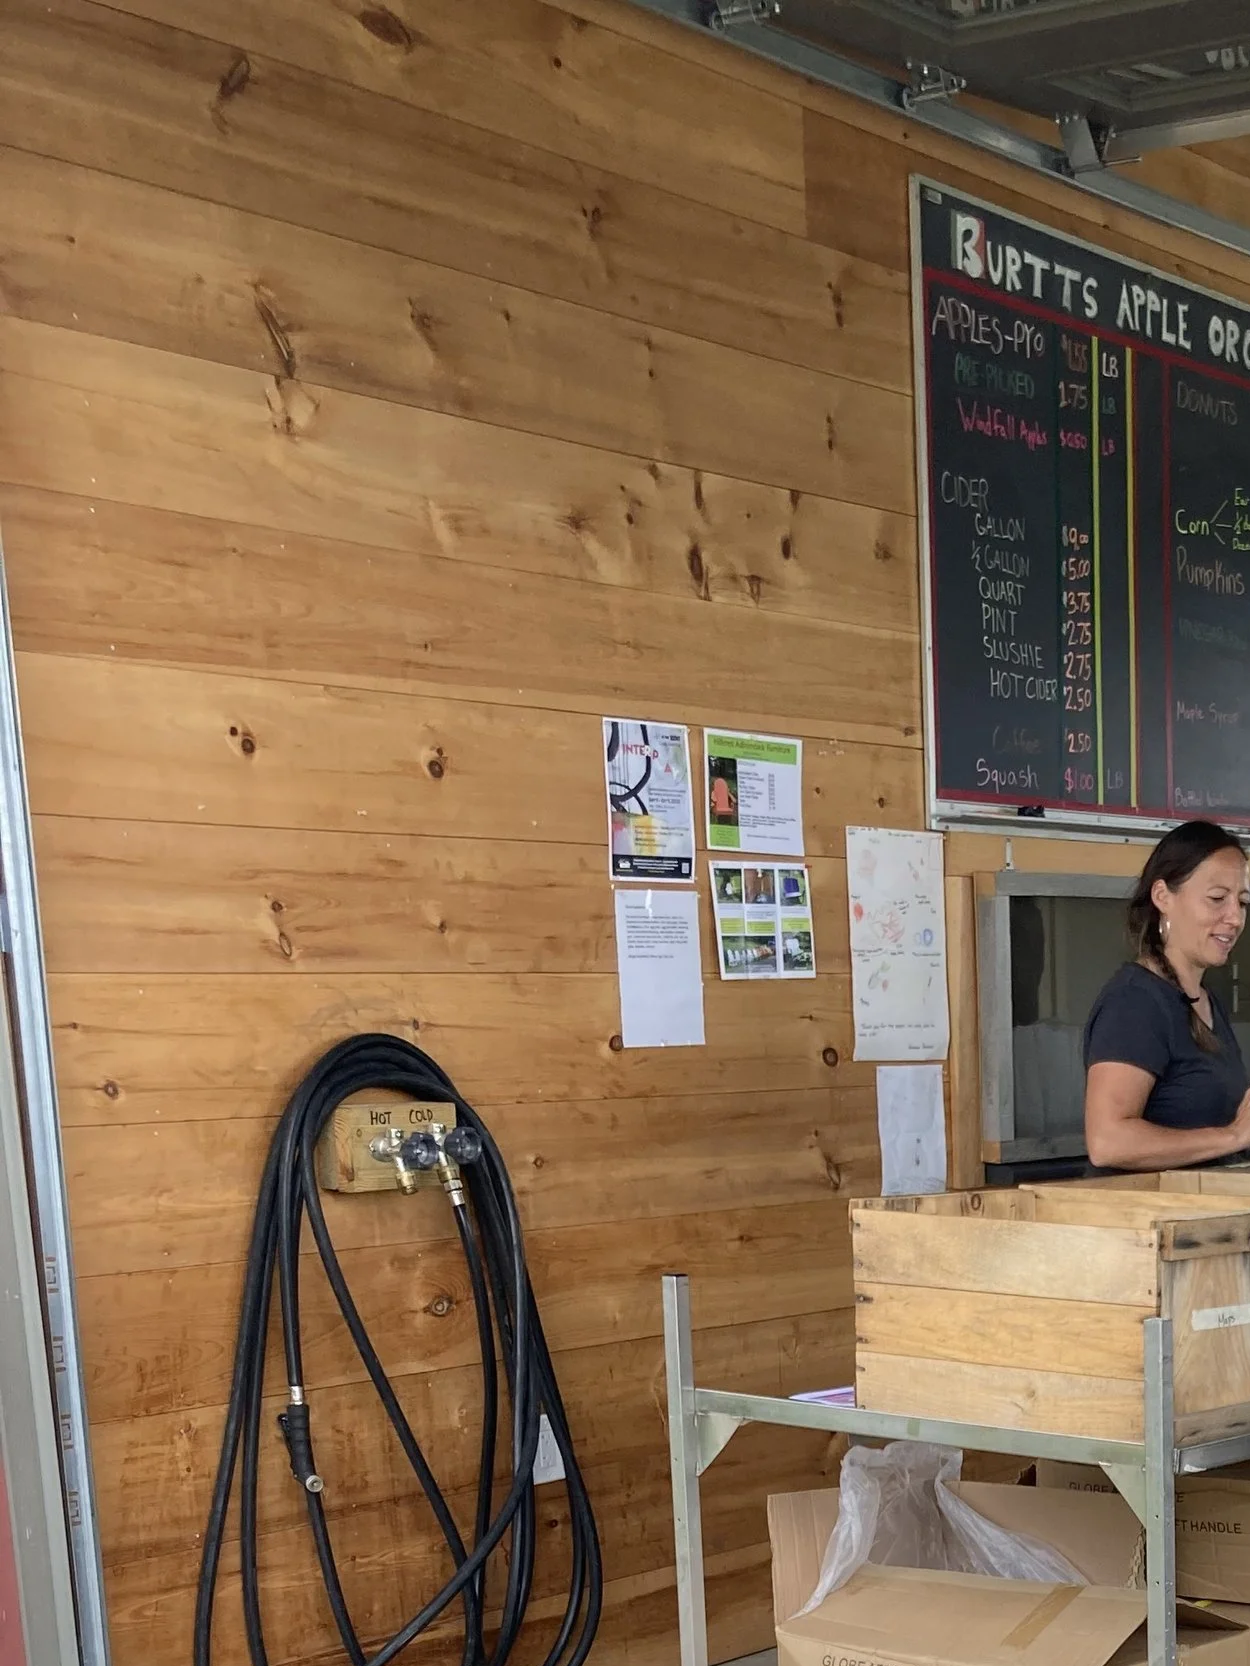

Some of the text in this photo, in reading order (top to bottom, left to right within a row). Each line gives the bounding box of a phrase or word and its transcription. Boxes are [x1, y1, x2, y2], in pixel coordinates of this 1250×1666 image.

[952, 211, 1098, 318] BURTTS
[1116, 279, 1192, 350] APPLE
[1102, 352, 1118, 378] LB
[941, 470, 991, 513] CIDER
[974, 513, 1026, 542] GALLON
[1175, 508, 1210, 536] Corn
[984, 544, 1030, 578] GALLON
[978, 576, 1026, 606] QUART
[982, 602, 1018, 636] PINT
[983, 635, 1045, 670] SLUSHIE
[990, 667, 1024, 699] HOT
[1025, 676, 1058, 702] CIDER
[976, 757, 1040, 794] Squash
[1107, 767, 1124, 789] LB
[370, 1109, 433, 1125] HOT COLD
[1190, 1519, 1242, 1535] HANDLE
